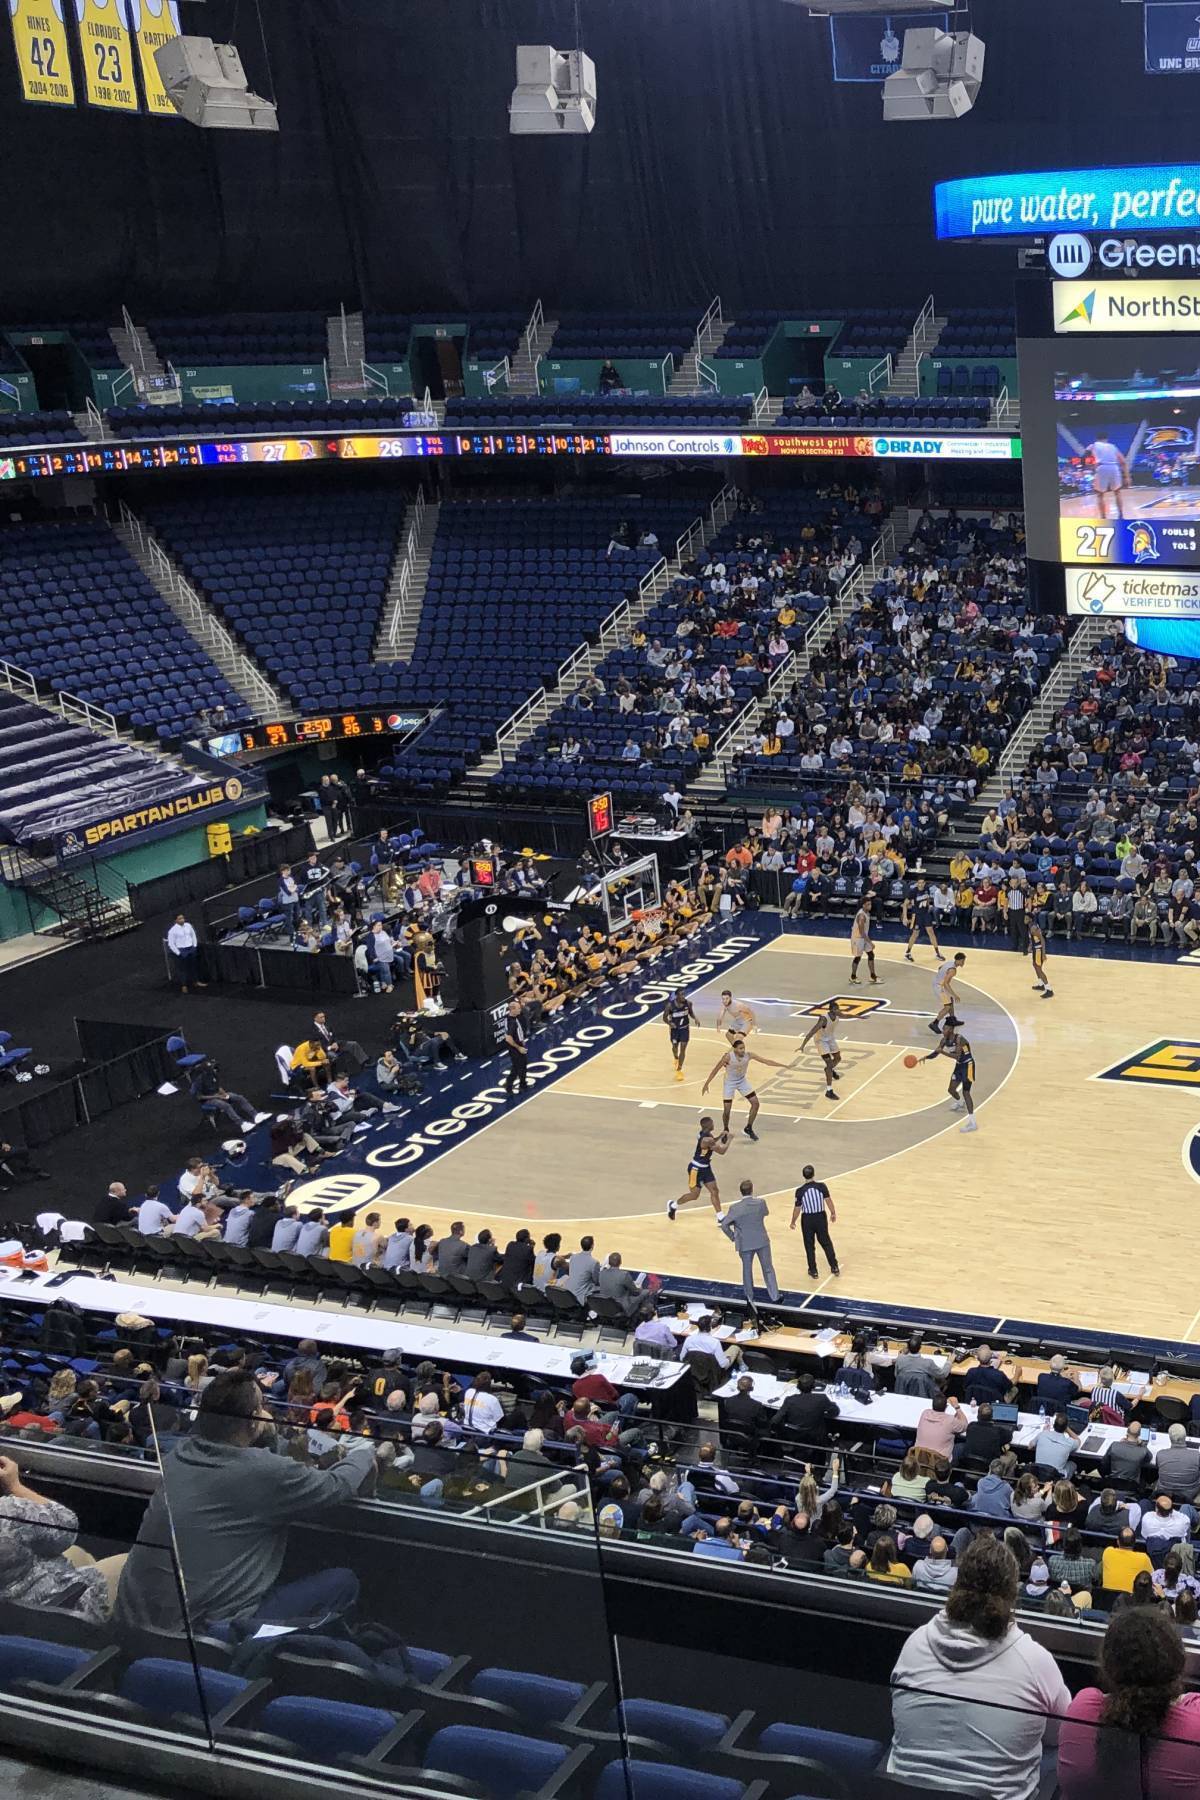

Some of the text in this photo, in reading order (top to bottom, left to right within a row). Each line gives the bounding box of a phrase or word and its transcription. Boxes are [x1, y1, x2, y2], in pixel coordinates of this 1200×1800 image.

[27, 15, 51, 32] HINES
[87, 22, 121, 41] ELDRIDGE
[31, 37, 59, 77] 42
[94, 43, 122, 83] 23
[1159, 58, 1182, 69] UNC
[971, 196, 1013, 233] pure
[1020, 187, 1099, 226] water,
[462, 440, 470, 451] 0
[496, 438, 503, 450] 1
[528, 439, 536, 449] 2
[556, 438, 567, 449] 10
[584, 439, 595, 450] 21
[614, 438, 719, 453] Johnson Controls
[774, 437, 849, 448] southwest grill
[890, 440, 944, 454] BRADY
[262, 445, 287, 461] 27
[343, 441, 358, 457] A
[379, 441, 403, 457] 26
[88, 455, 102, 466] 11
[126, 452, 142, 464] 14
[165, 451, 178, 462] 21
[18, 461, 26, 472] 1
[53, 458, 62, 470] 2
[1162, 528, 1189, 536] FOULS
[1076, 525, 1115, 557] 27
[1172, 541, 1197, 551] TOL 3
[1122, 597, 1172, 608] VERIFIED
[304, 719, 332, 734] 2:50
[344, 723, 360, 735] 26
[374, 720, 382, 732] 3
[271, 732, 287, 745] 27
[592, 796, 609, 814] 2:50
[85, 786, 225, 845] SPARTAN CLUB
[603, 936, 761, 1019] Coliseum
[374, 1377, 386, 1396] 0
